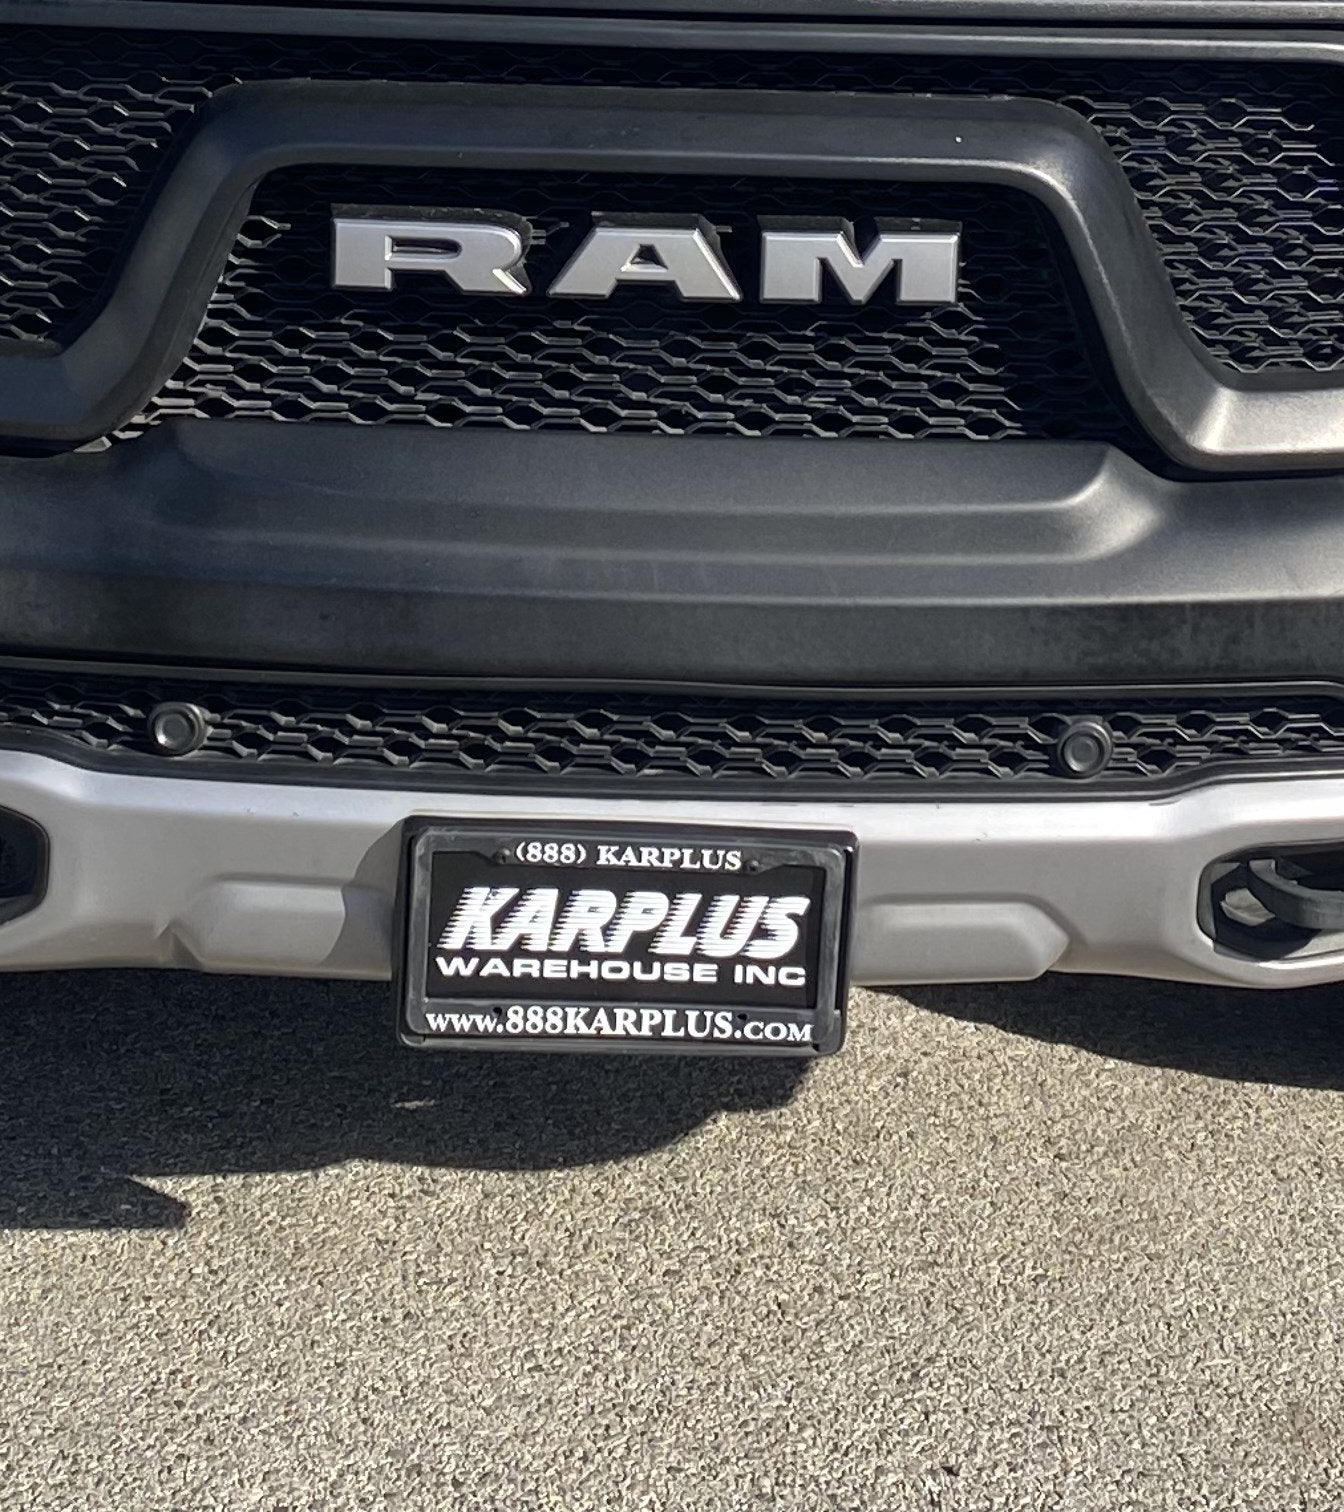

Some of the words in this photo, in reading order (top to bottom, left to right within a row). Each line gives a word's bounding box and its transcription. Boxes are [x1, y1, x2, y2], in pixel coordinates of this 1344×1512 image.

[331, 206, 962, 304] RAM
[515, 842, 587, 865] (888)
[596, 846, 742, 871] KARPLUS
[437, 887, 811, 959] KARPLUS
[435, 956, 717, 983] WAREHOUSE
[734, 964, 806, 987] INC
